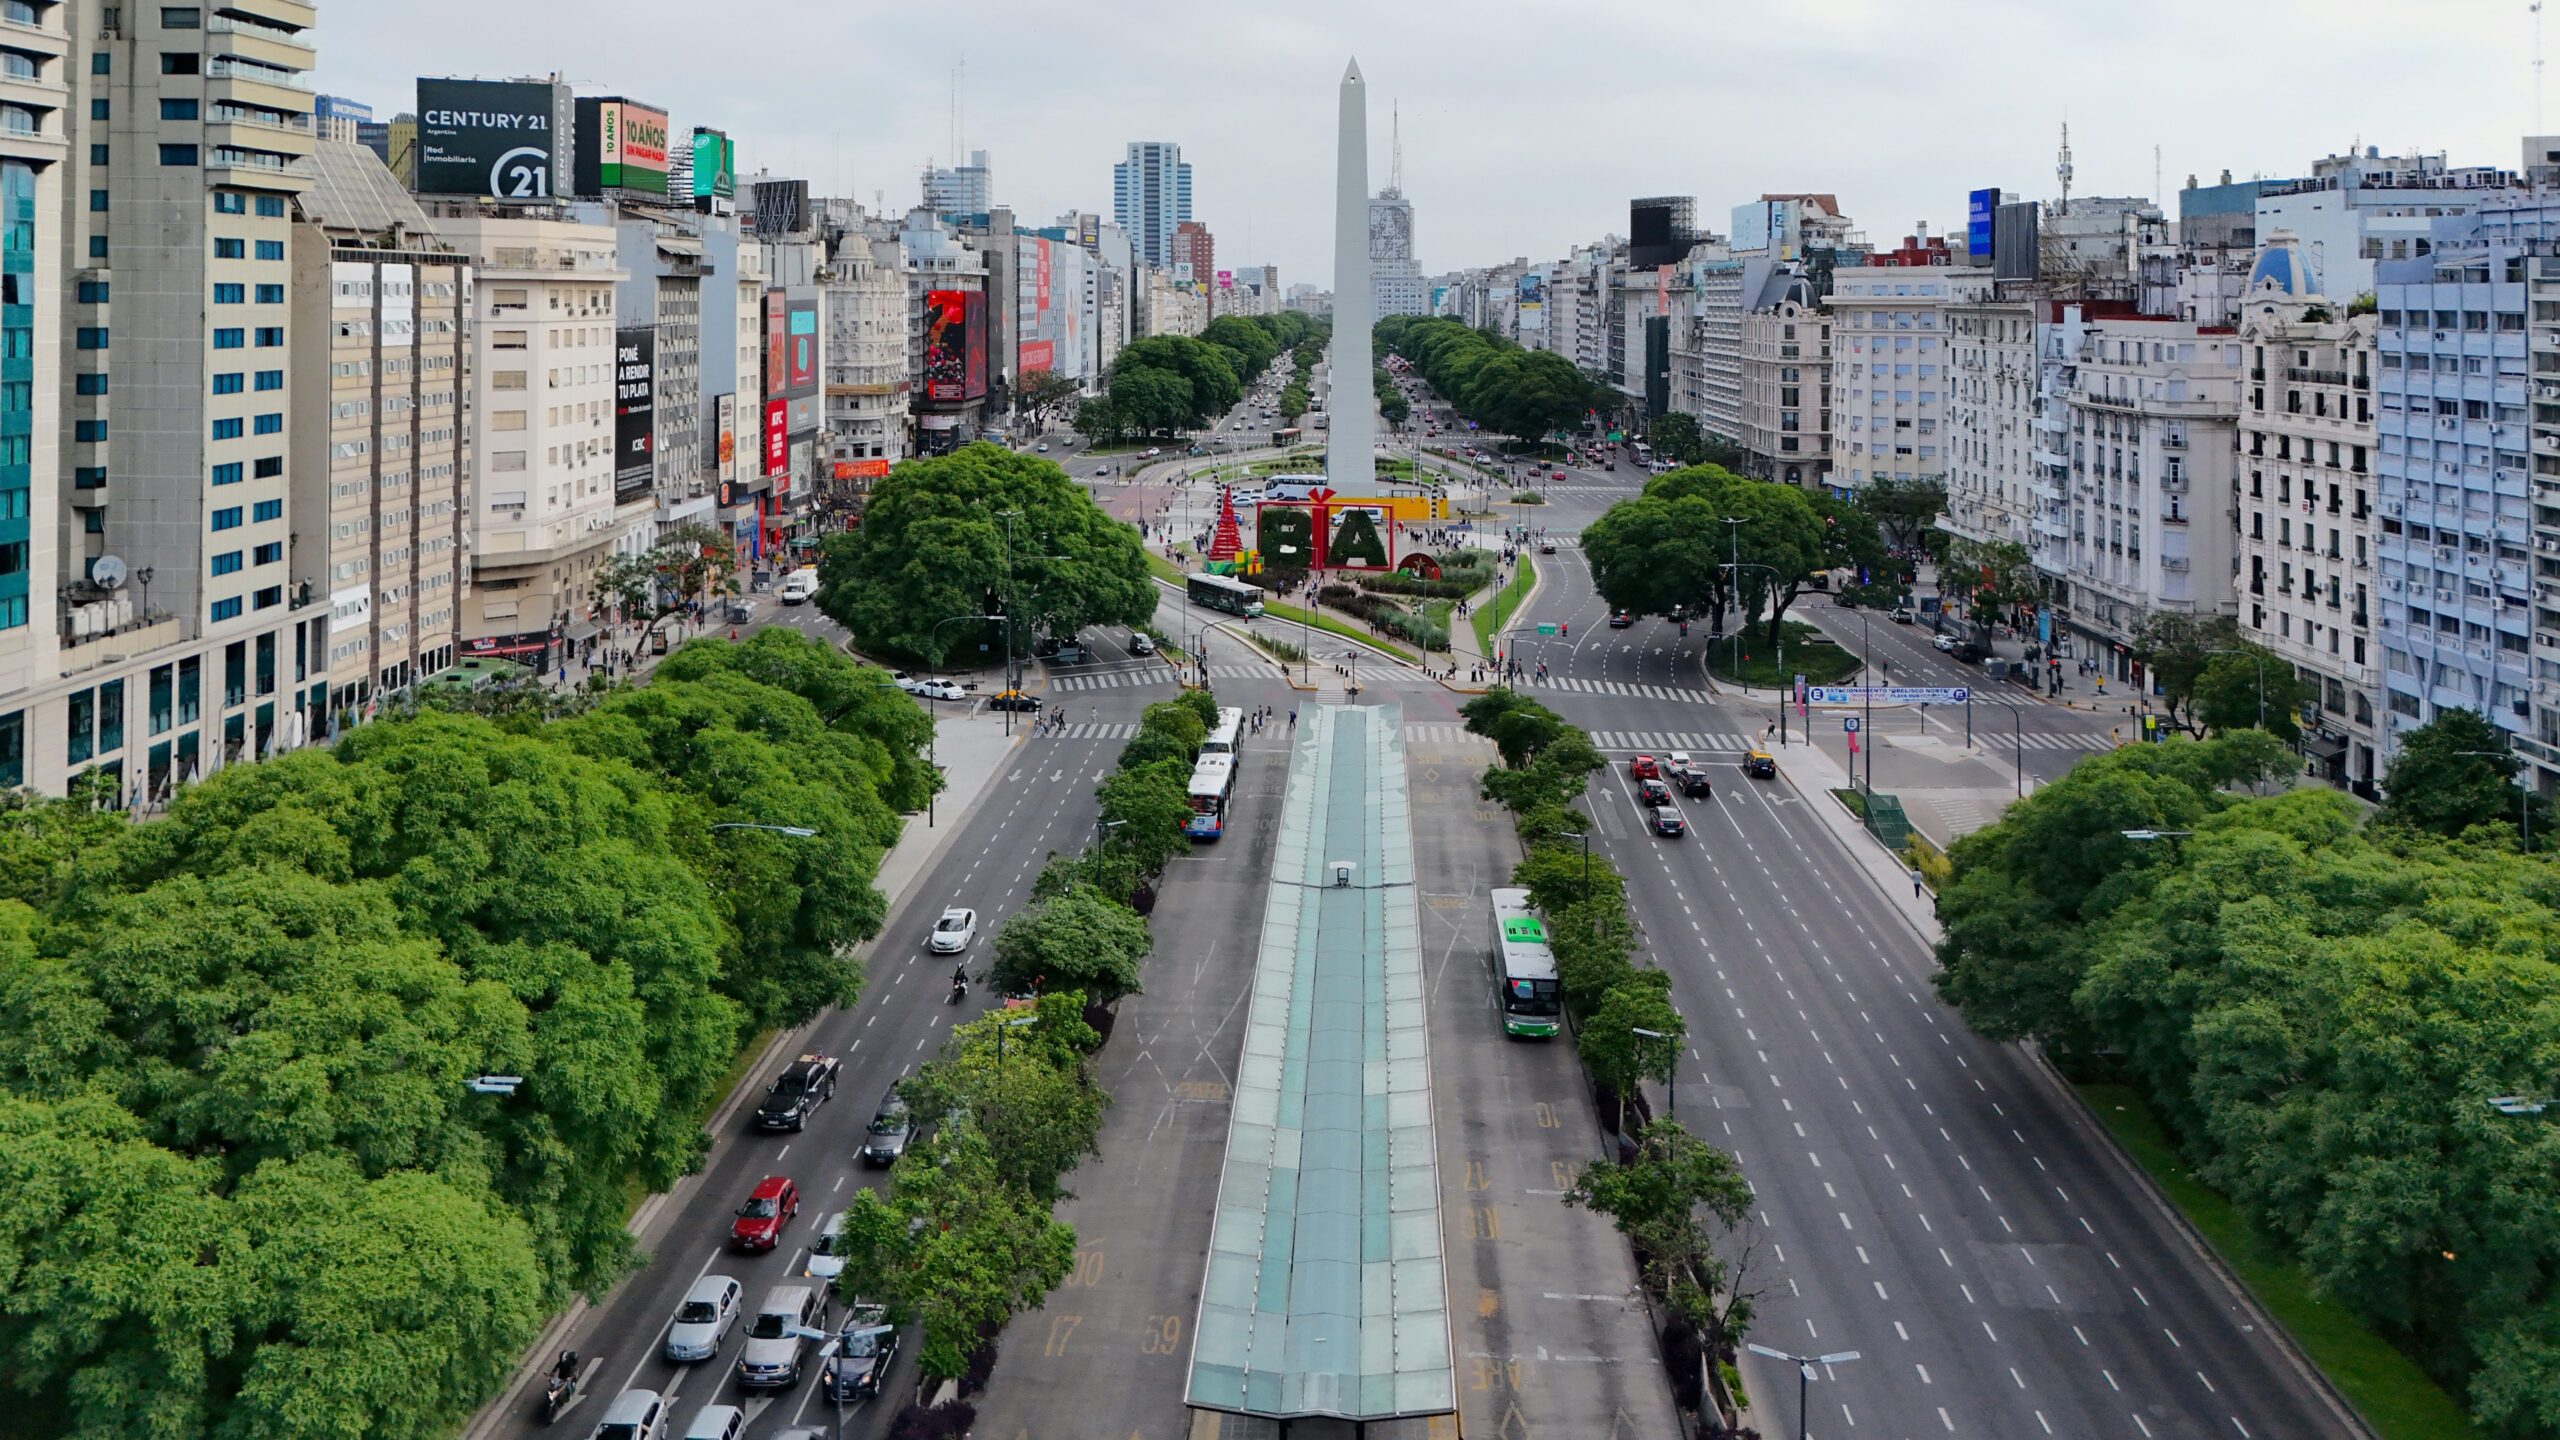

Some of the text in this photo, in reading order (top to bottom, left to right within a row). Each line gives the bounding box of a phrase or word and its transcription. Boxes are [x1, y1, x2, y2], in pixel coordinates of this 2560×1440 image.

[425, 110, 523, 129] CENTURY
[626, 119, 637, 143] 10
[638, 119, 666, 149] AÑOS
[427, 146, 444, 154] Red
[607, 142, 614, 153] 10
[427, 155, 476, 164] Inmobiliaria
[619, 344, 639, 362] PONÉ
[619, 364, 650, 380] A RENDIR
[619, 382, 649, 399] TU PLATA
[772, 410, 784, 426] KFC
[1044, 1315, 1083, 1357] 17
